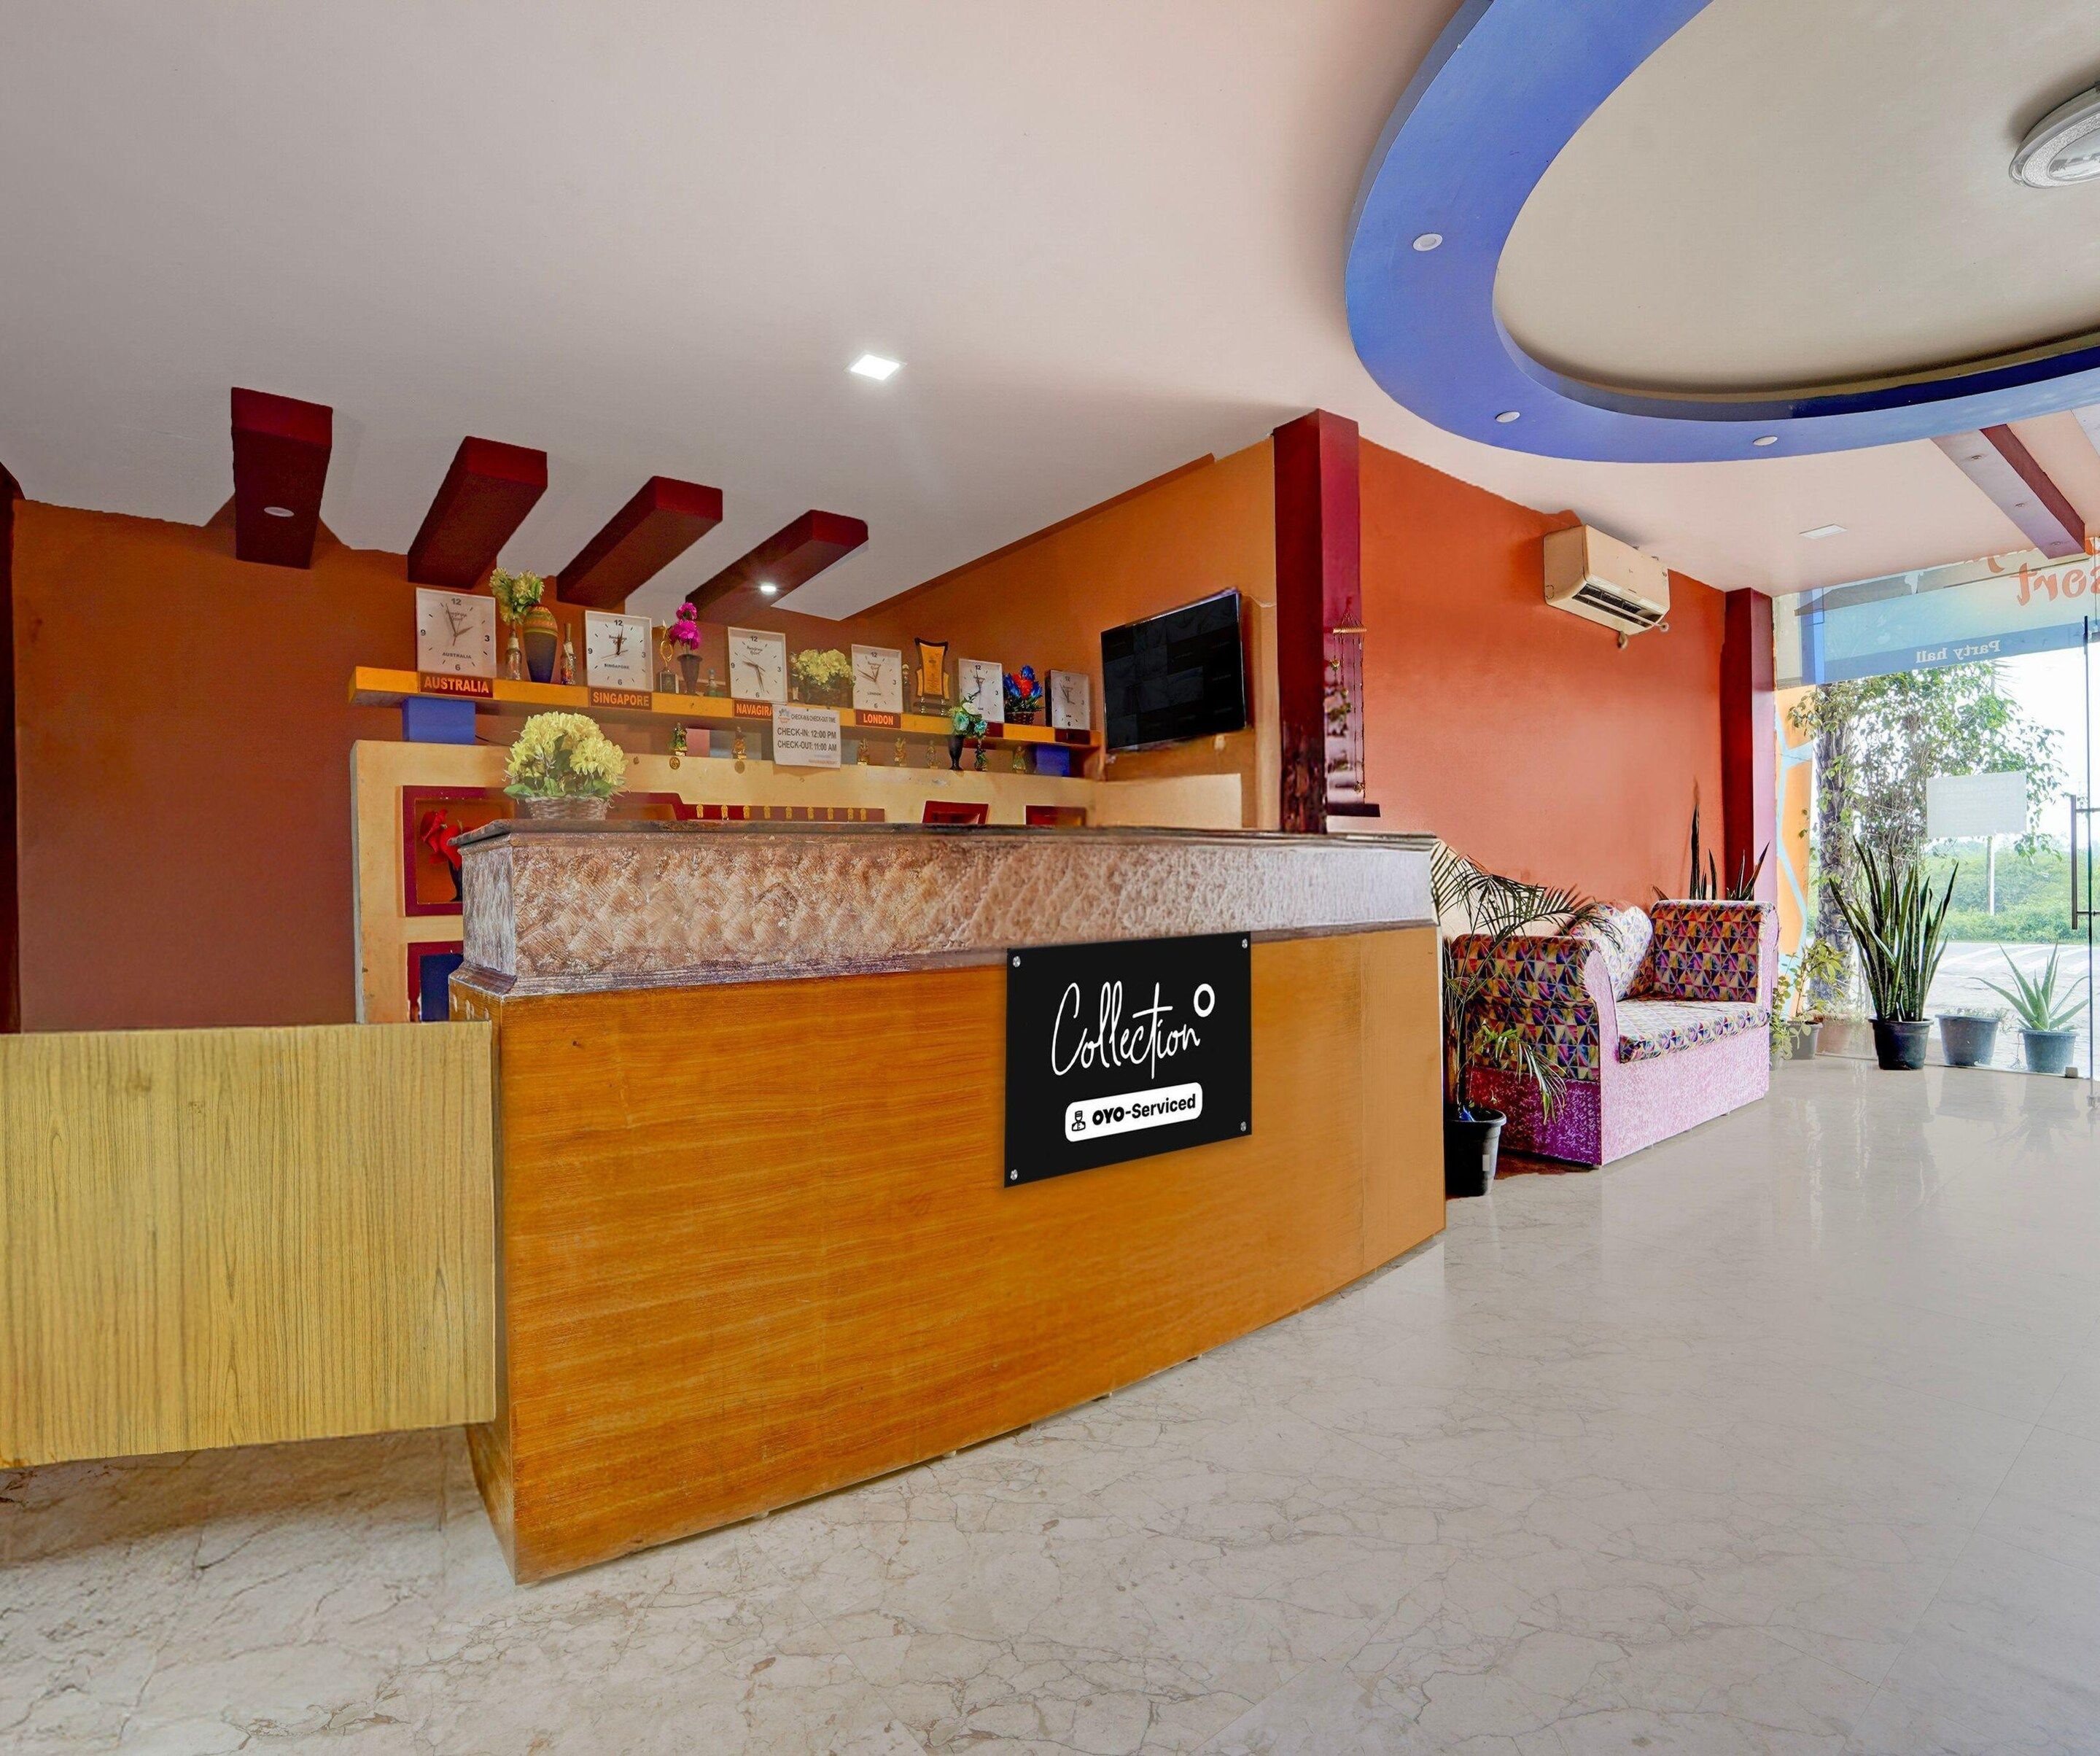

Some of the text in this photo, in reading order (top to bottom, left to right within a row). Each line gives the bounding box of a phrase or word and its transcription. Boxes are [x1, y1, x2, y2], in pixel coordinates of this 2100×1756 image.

[451, 598, 462, 606] 12
[424, 676, 489, 694] AUSTRALIA
[593, 691, 650, 707] SINGAPORE
[863, 713, 894, 726] LONDON
[777, 727, 836, 739] CHECK-IN: 12:00 PM
[777, 740, 837, 752] CHECK-OUT: 11:00 AM
[1051, 980, 1201, 1079] Collection
[1092, 1094, 1196, 1126] OYO-Serviced
